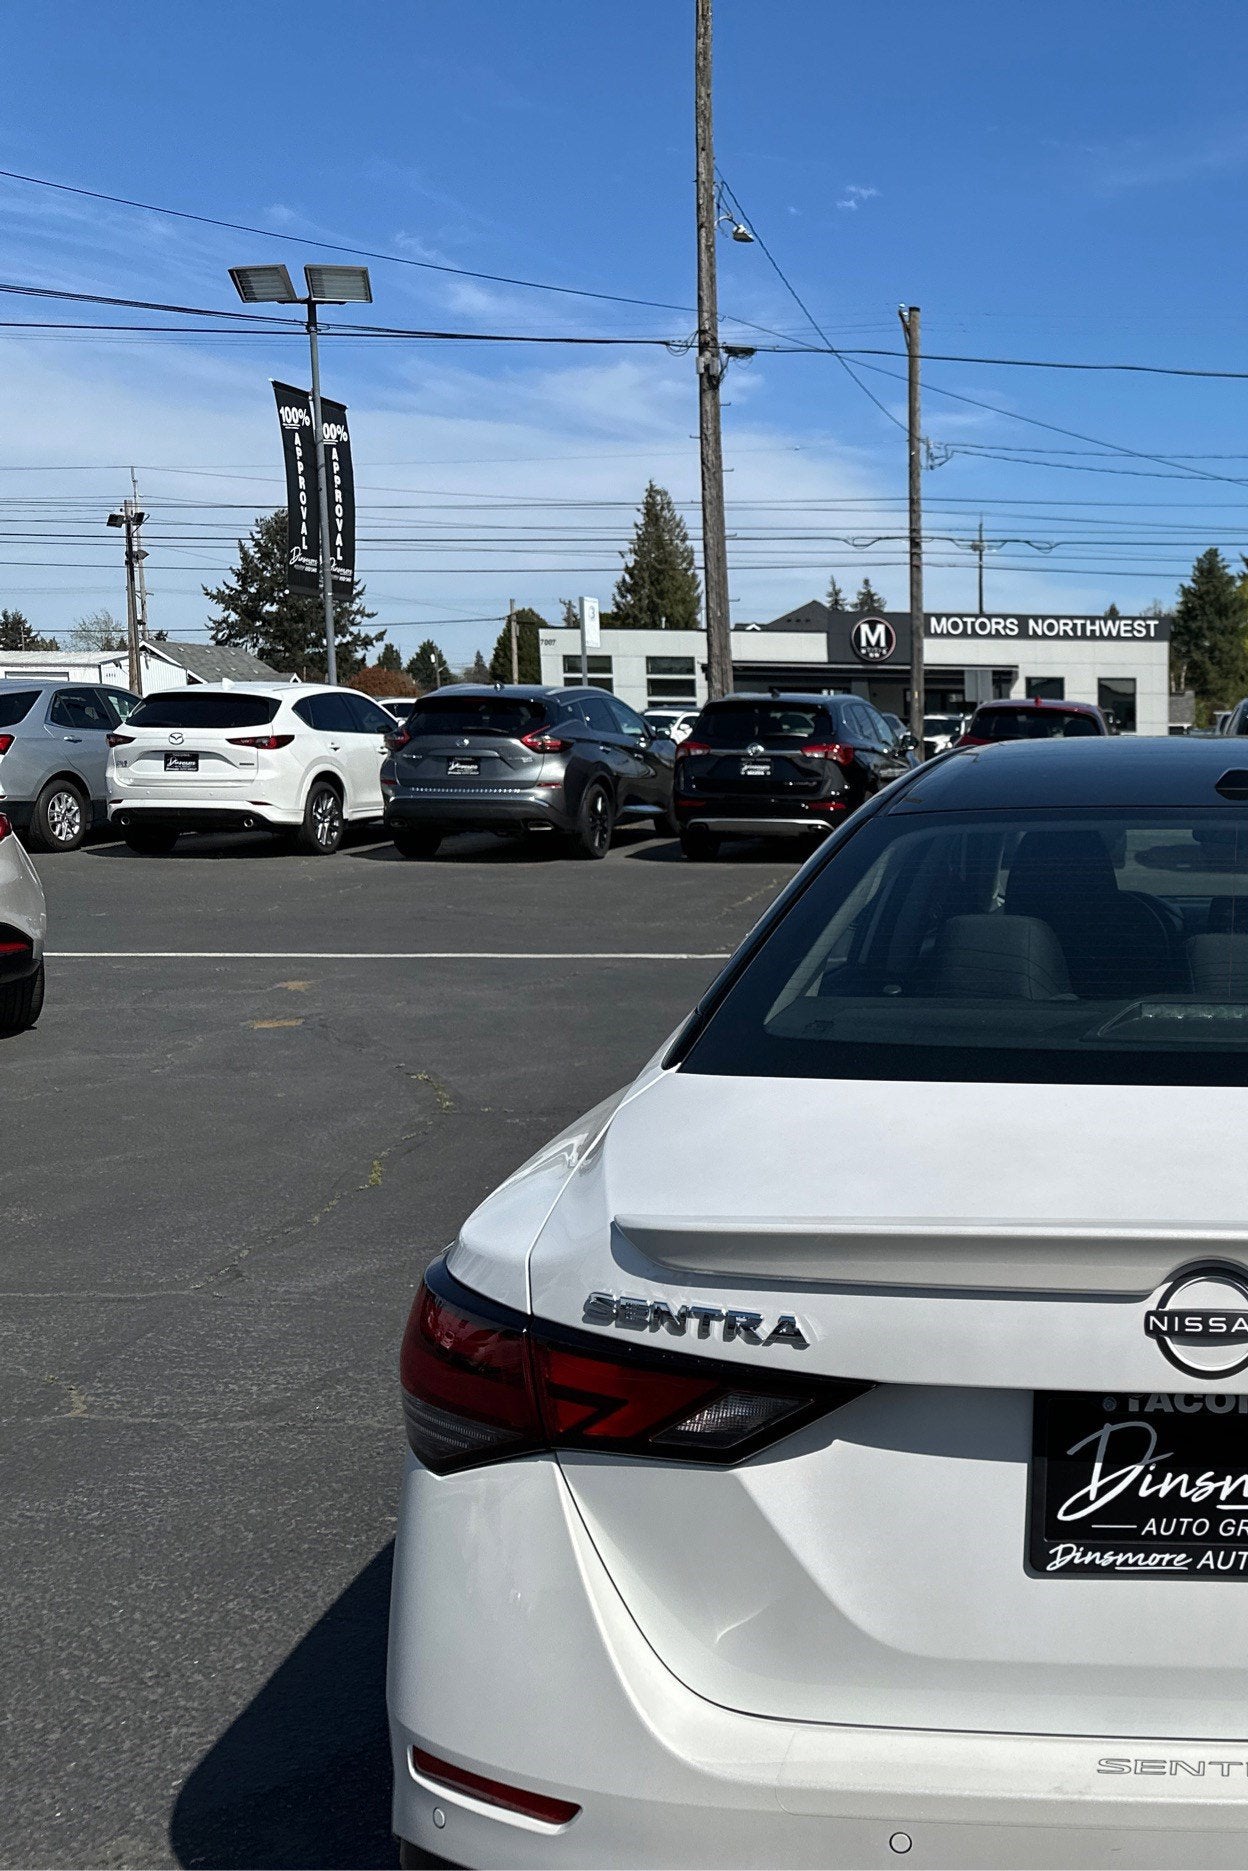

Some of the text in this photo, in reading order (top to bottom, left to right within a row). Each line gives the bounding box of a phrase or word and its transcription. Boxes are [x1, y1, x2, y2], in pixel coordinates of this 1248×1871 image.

[280, 406, 310, 426] 100%
[323, 423, 348, 441] 00%
[295, 432, 307, 549] APPROVAL
[332, 447, 343, 560] APPROVAL
[860, 623, 886, 647] M
[930, 616, 1159, 638] MOTORS NORTHWEST
[582, 1291, 811, 1351] SENTRA
[1141, 1517, 1210, 1537] AUTO
[1046, 1543, 1194, 1571] Dinsmore
